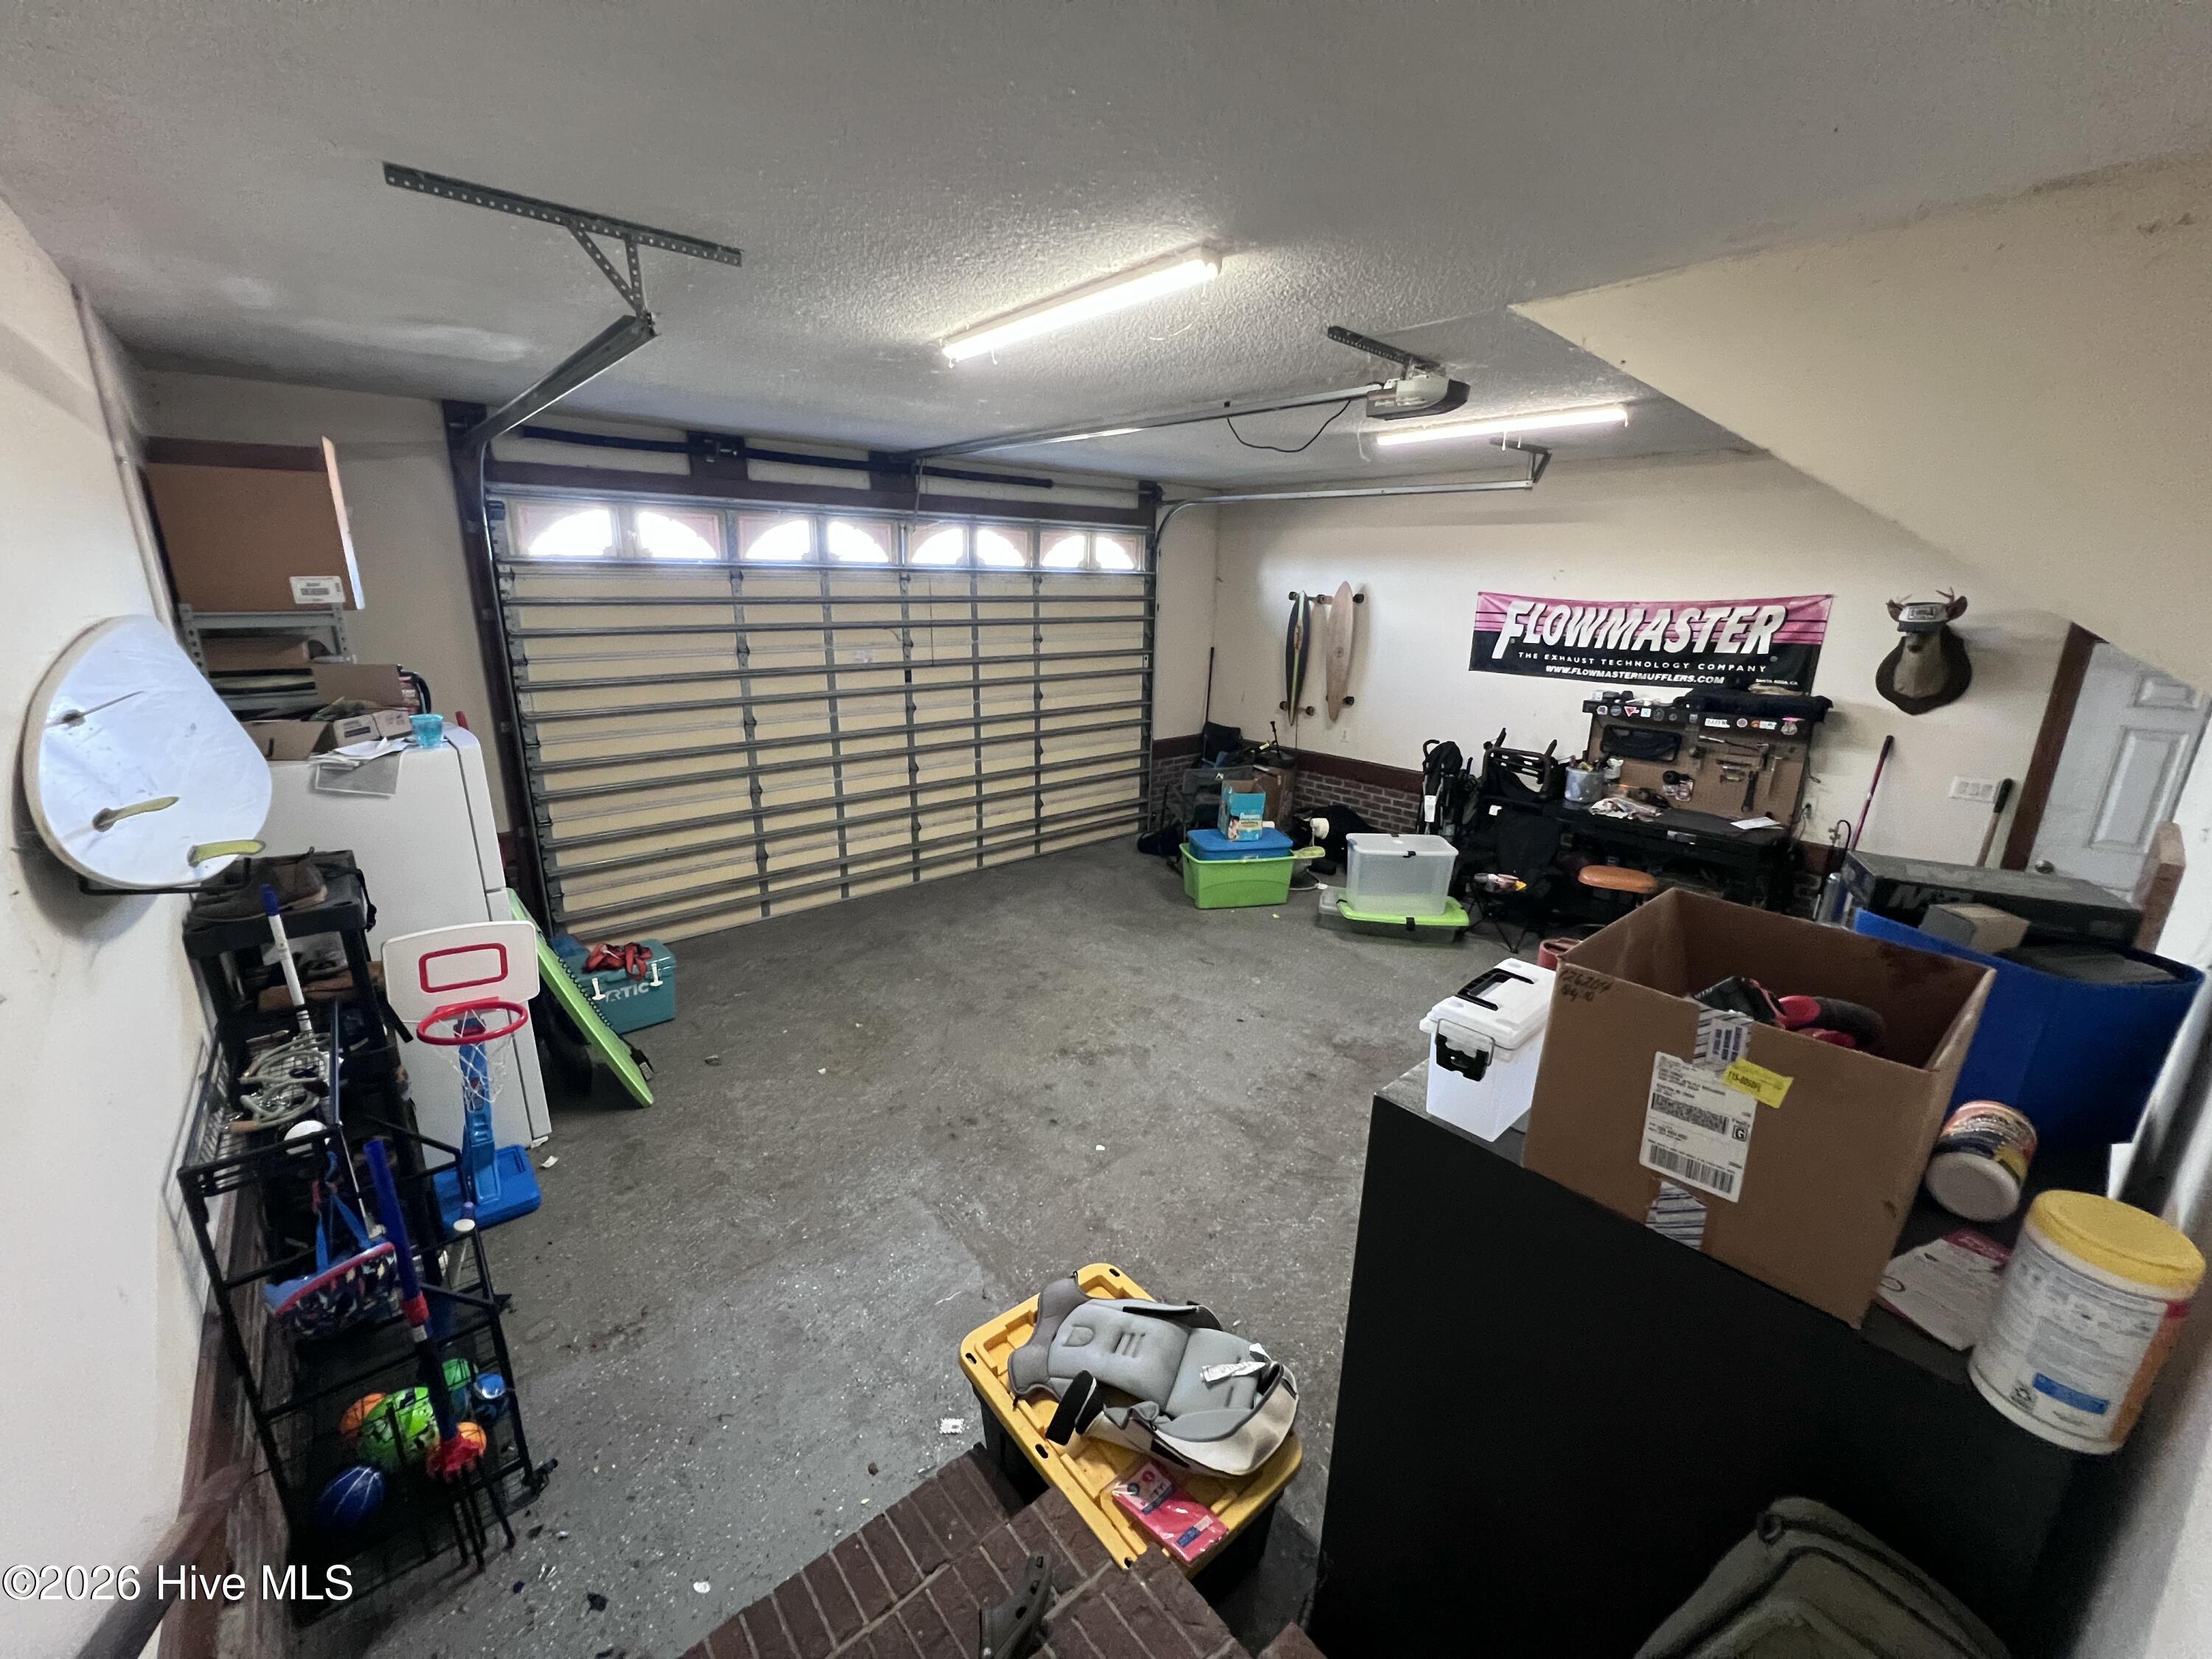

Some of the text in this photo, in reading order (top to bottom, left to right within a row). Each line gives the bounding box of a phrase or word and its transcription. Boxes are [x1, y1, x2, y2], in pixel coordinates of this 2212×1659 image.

[1492, 601, 1787, 658] FLOWMASTER
[1544, 654, 1595, 665] EXHAUST
[1601, 658, 1690, 669] TECHNOLOGY
[1698, 663, 1767, 672] COMPANY
[1545, 665, 1725, 684] WWW.FLOWMASTERMUFFLERS.COM
